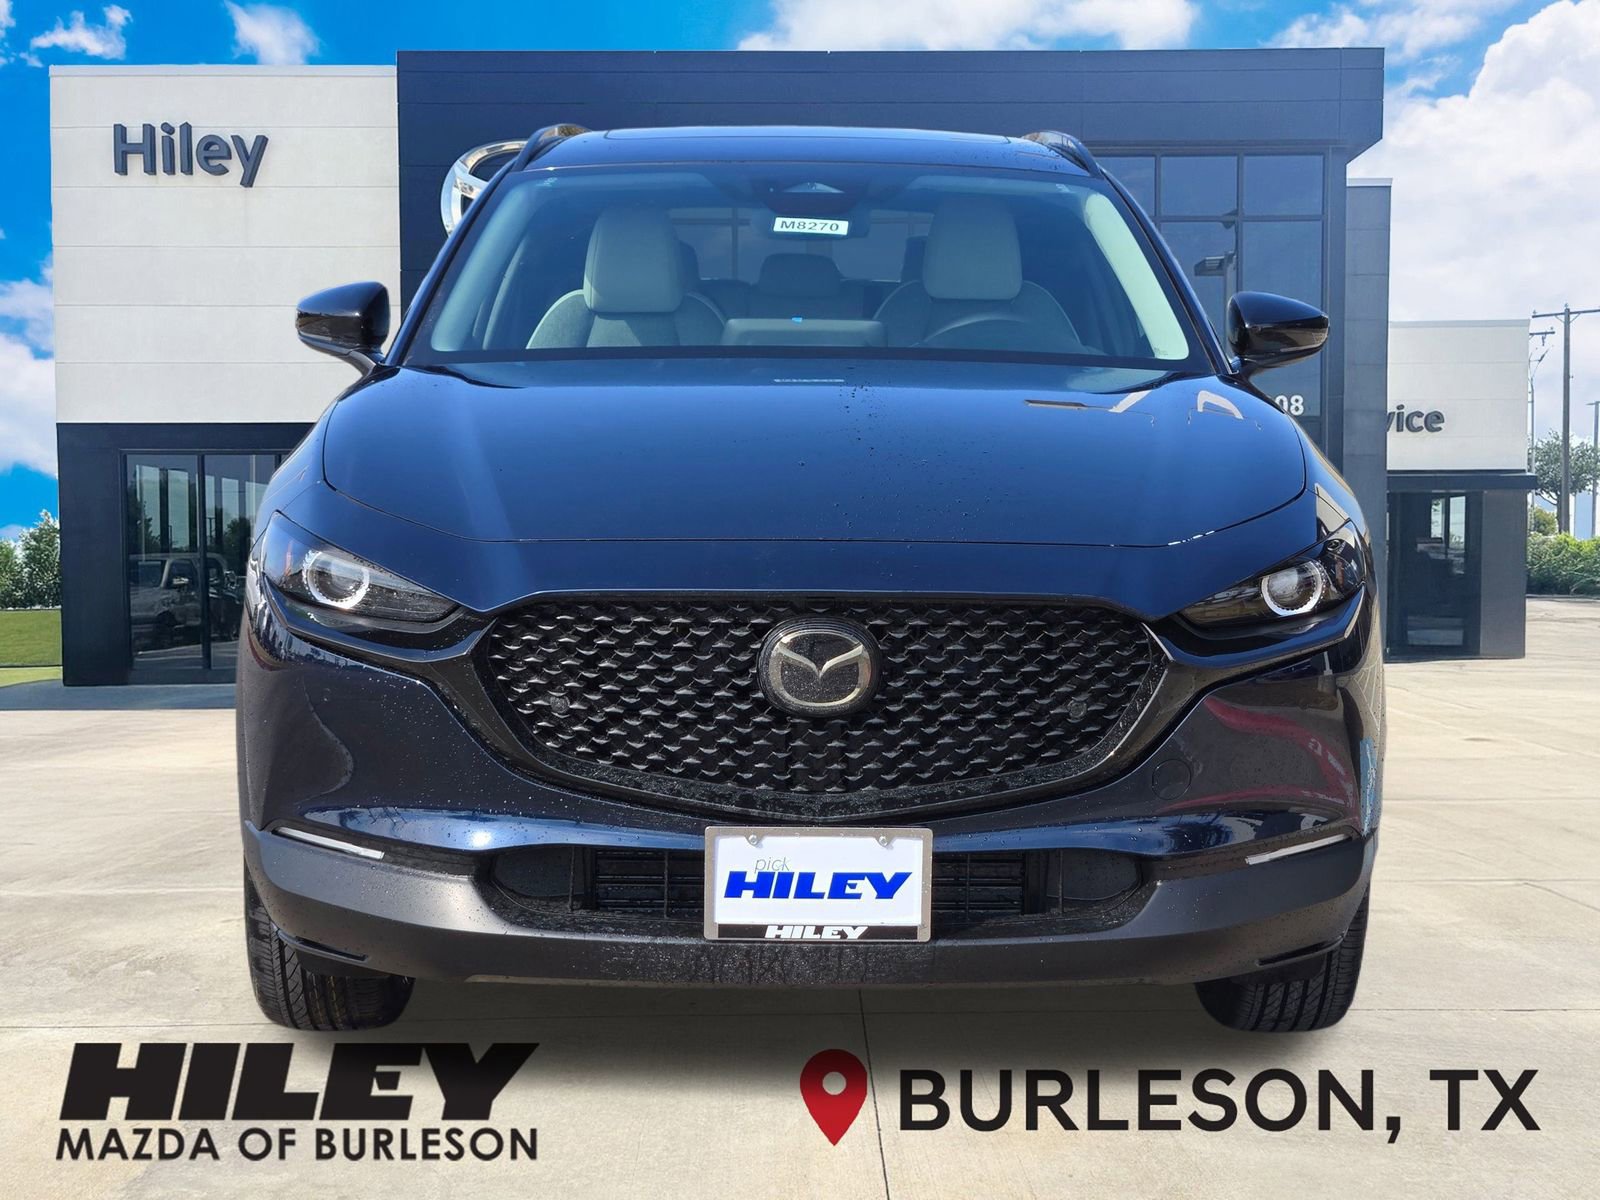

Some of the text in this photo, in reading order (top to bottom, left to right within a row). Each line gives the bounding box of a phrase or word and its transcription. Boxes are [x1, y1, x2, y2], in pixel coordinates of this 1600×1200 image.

[113, 121, 269, 188] Hiley
[780, 220, 840, 232] M8270
[754, 857, 791, 873] pick
[724, 871, 913, 900] HILEY
[765, 925, 869, 940] HILEY
